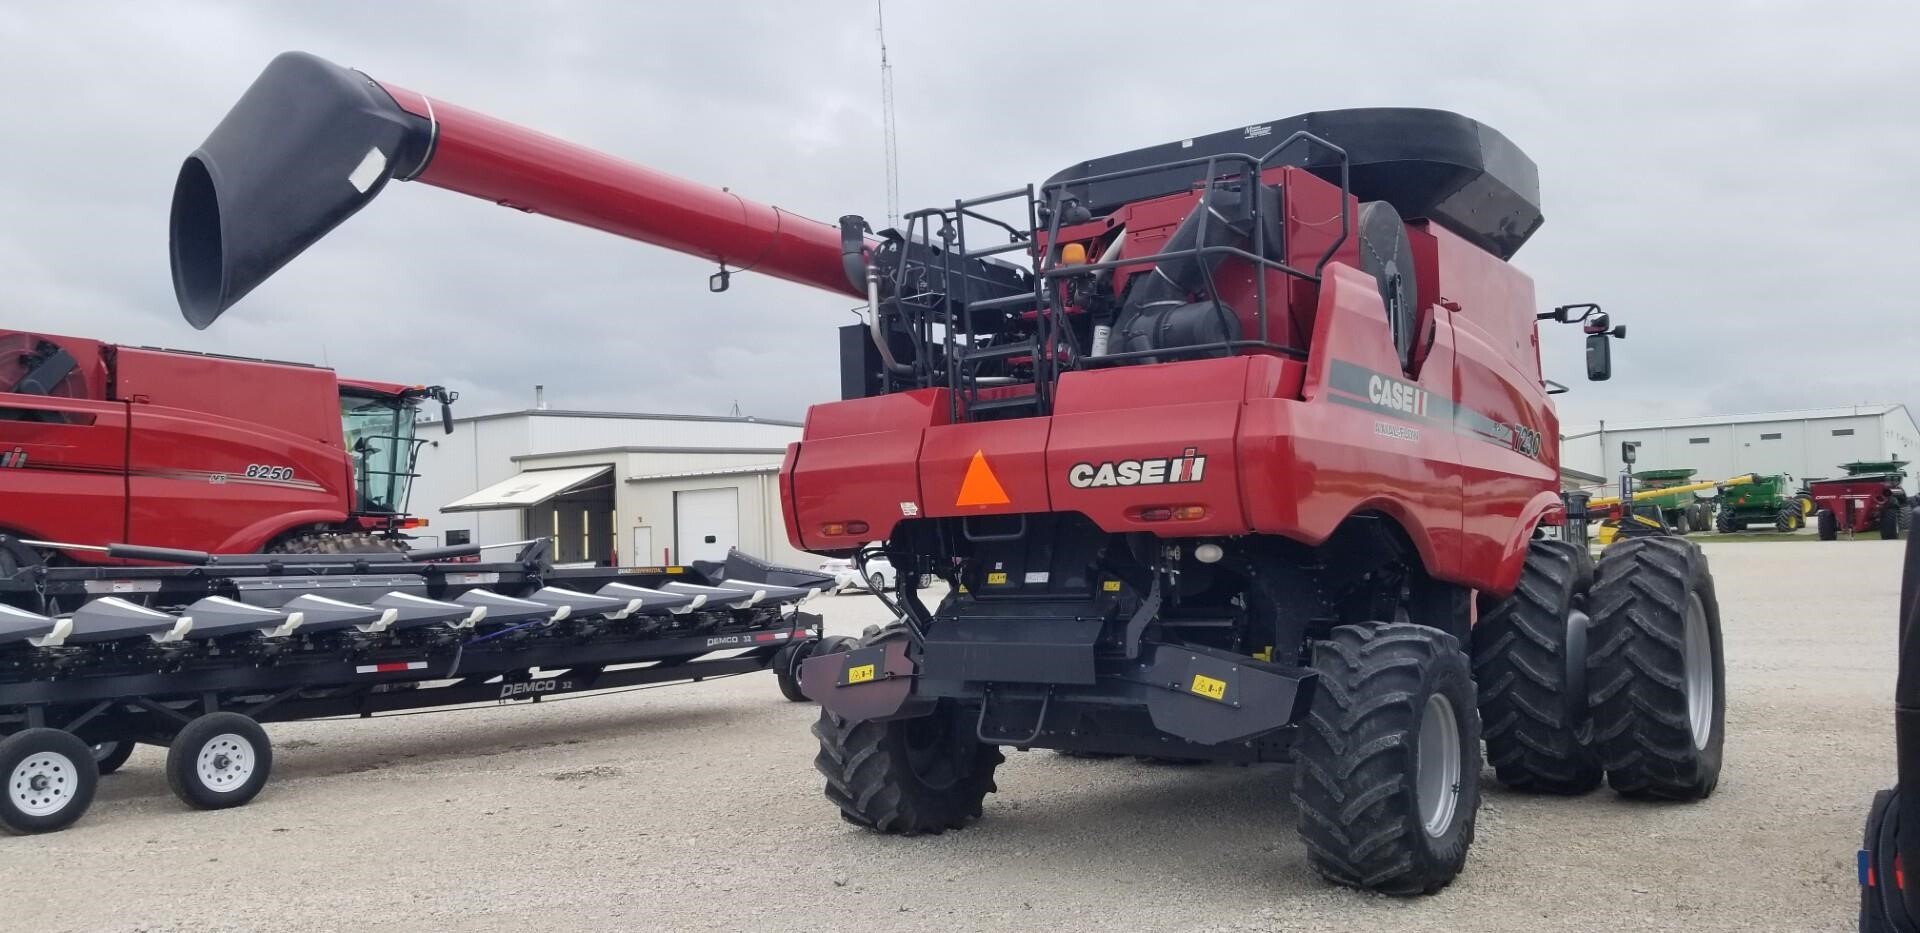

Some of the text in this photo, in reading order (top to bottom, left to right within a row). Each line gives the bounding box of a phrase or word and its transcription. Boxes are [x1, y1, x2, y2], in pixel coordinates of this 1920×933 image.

[1369, 374, 1413, 413] CASE
[1514, 423, 1541, 459] 7230
[246, 464, 294, 481] 8250
[1068, 460, 1167, 488] CASE
[707, 636, 738, 647] DEMCO
[500, 680, 573, 697] DEMCO 32
